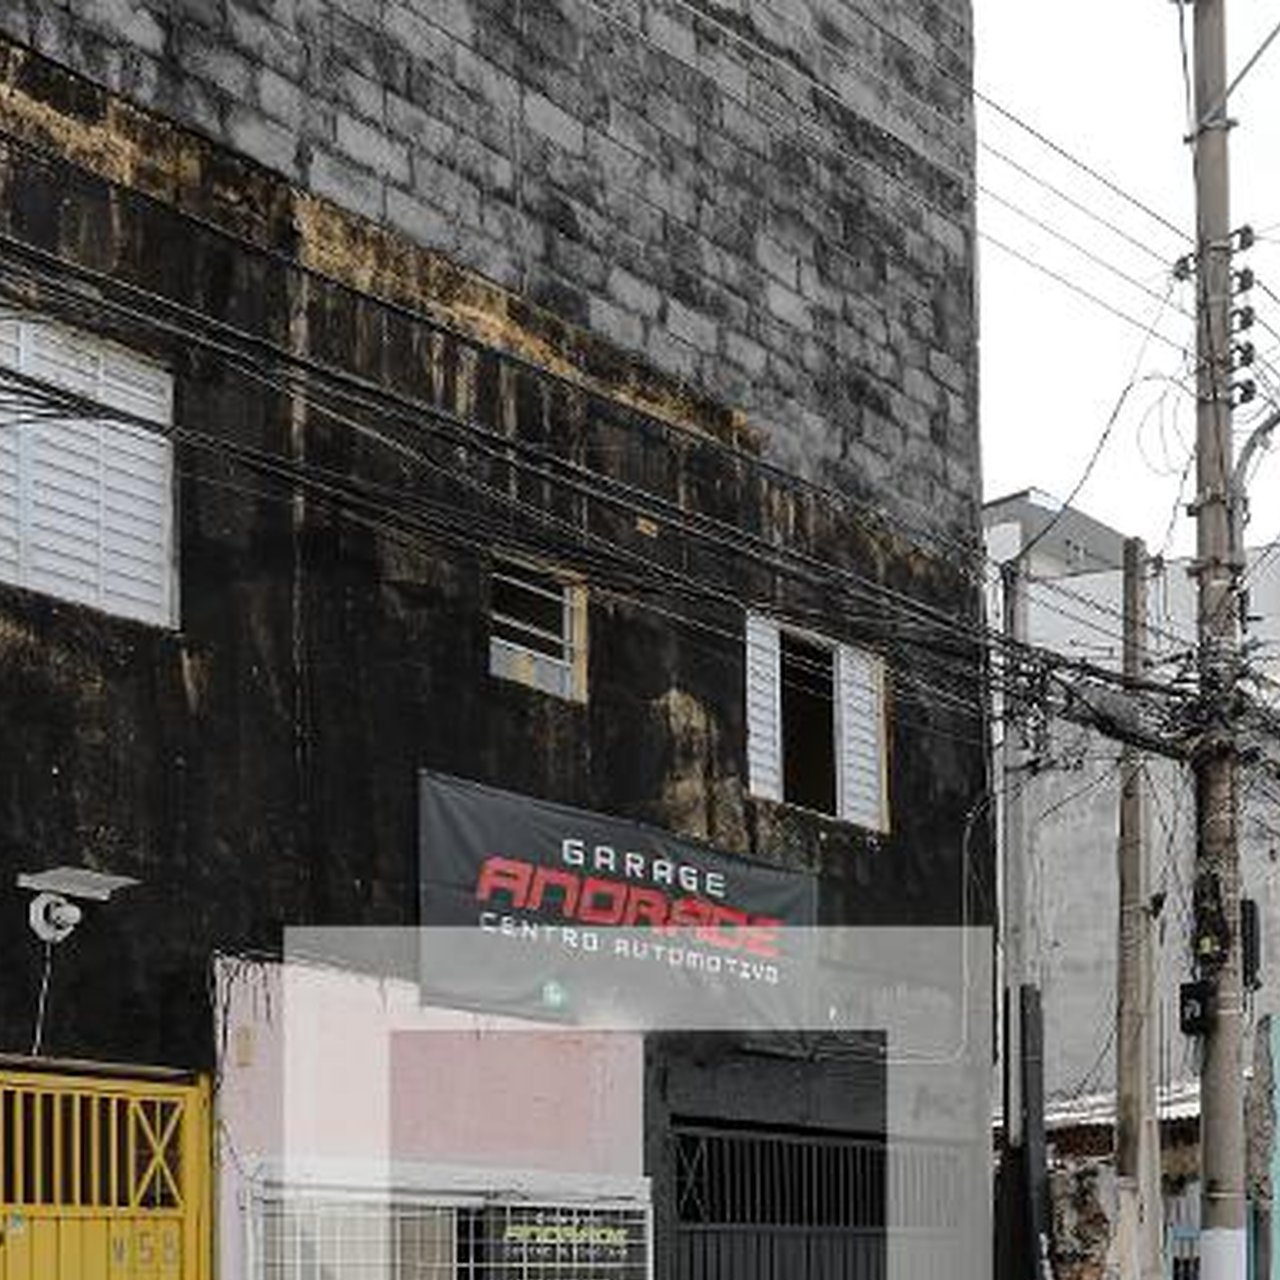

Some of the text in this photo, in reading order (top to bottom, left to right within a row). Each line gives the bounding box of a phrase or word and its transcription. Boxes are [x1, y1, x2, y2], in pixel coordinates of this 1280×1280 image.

[562, 839, 725, 898] GARAGE
[476, 855, 787, 957] ANDRADE
[480, 911, 779, 984] CENTRO AUTOMOTIVO
